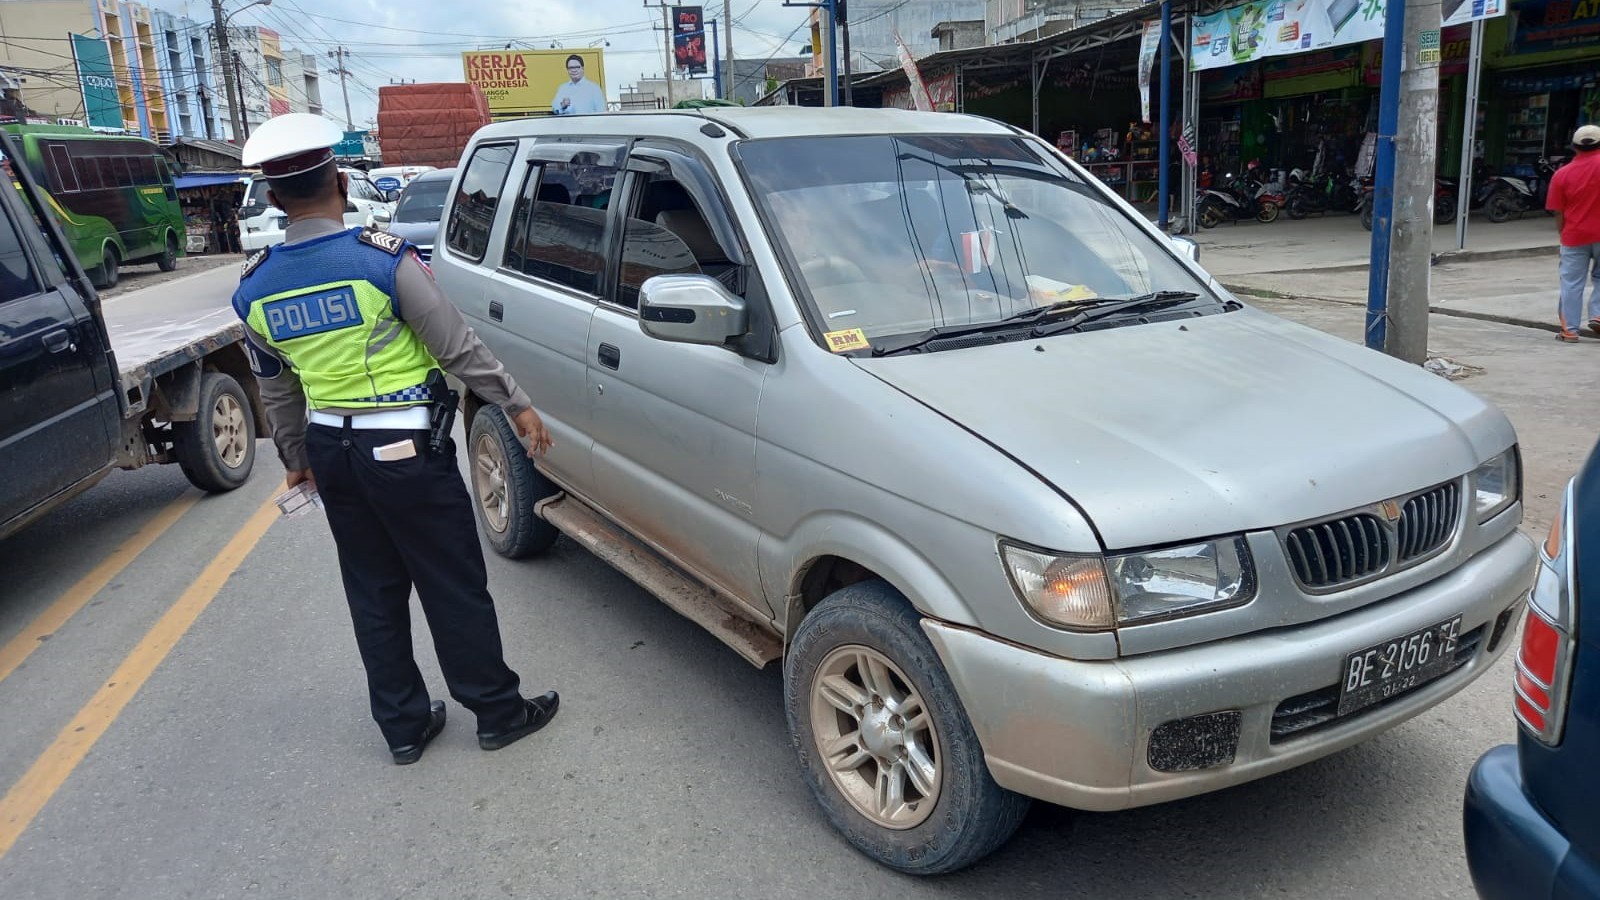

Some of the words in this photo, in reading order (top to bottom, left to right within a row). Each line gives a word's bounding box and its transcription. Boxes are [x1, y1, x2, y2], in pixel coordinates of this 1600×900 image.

[679, 14, 697, 23] PRO
[465, 54, 527, 69] KERJA
[468, 67, 528, 81] UNTUK
[268, 292, 361, 336] POLISI
[831, 333, 860, 346] RM
[1346, 649, 1377, 692] BE
[1381, 631, 1432, 679] 2156
[1438, 618, 1461, 657] TE
